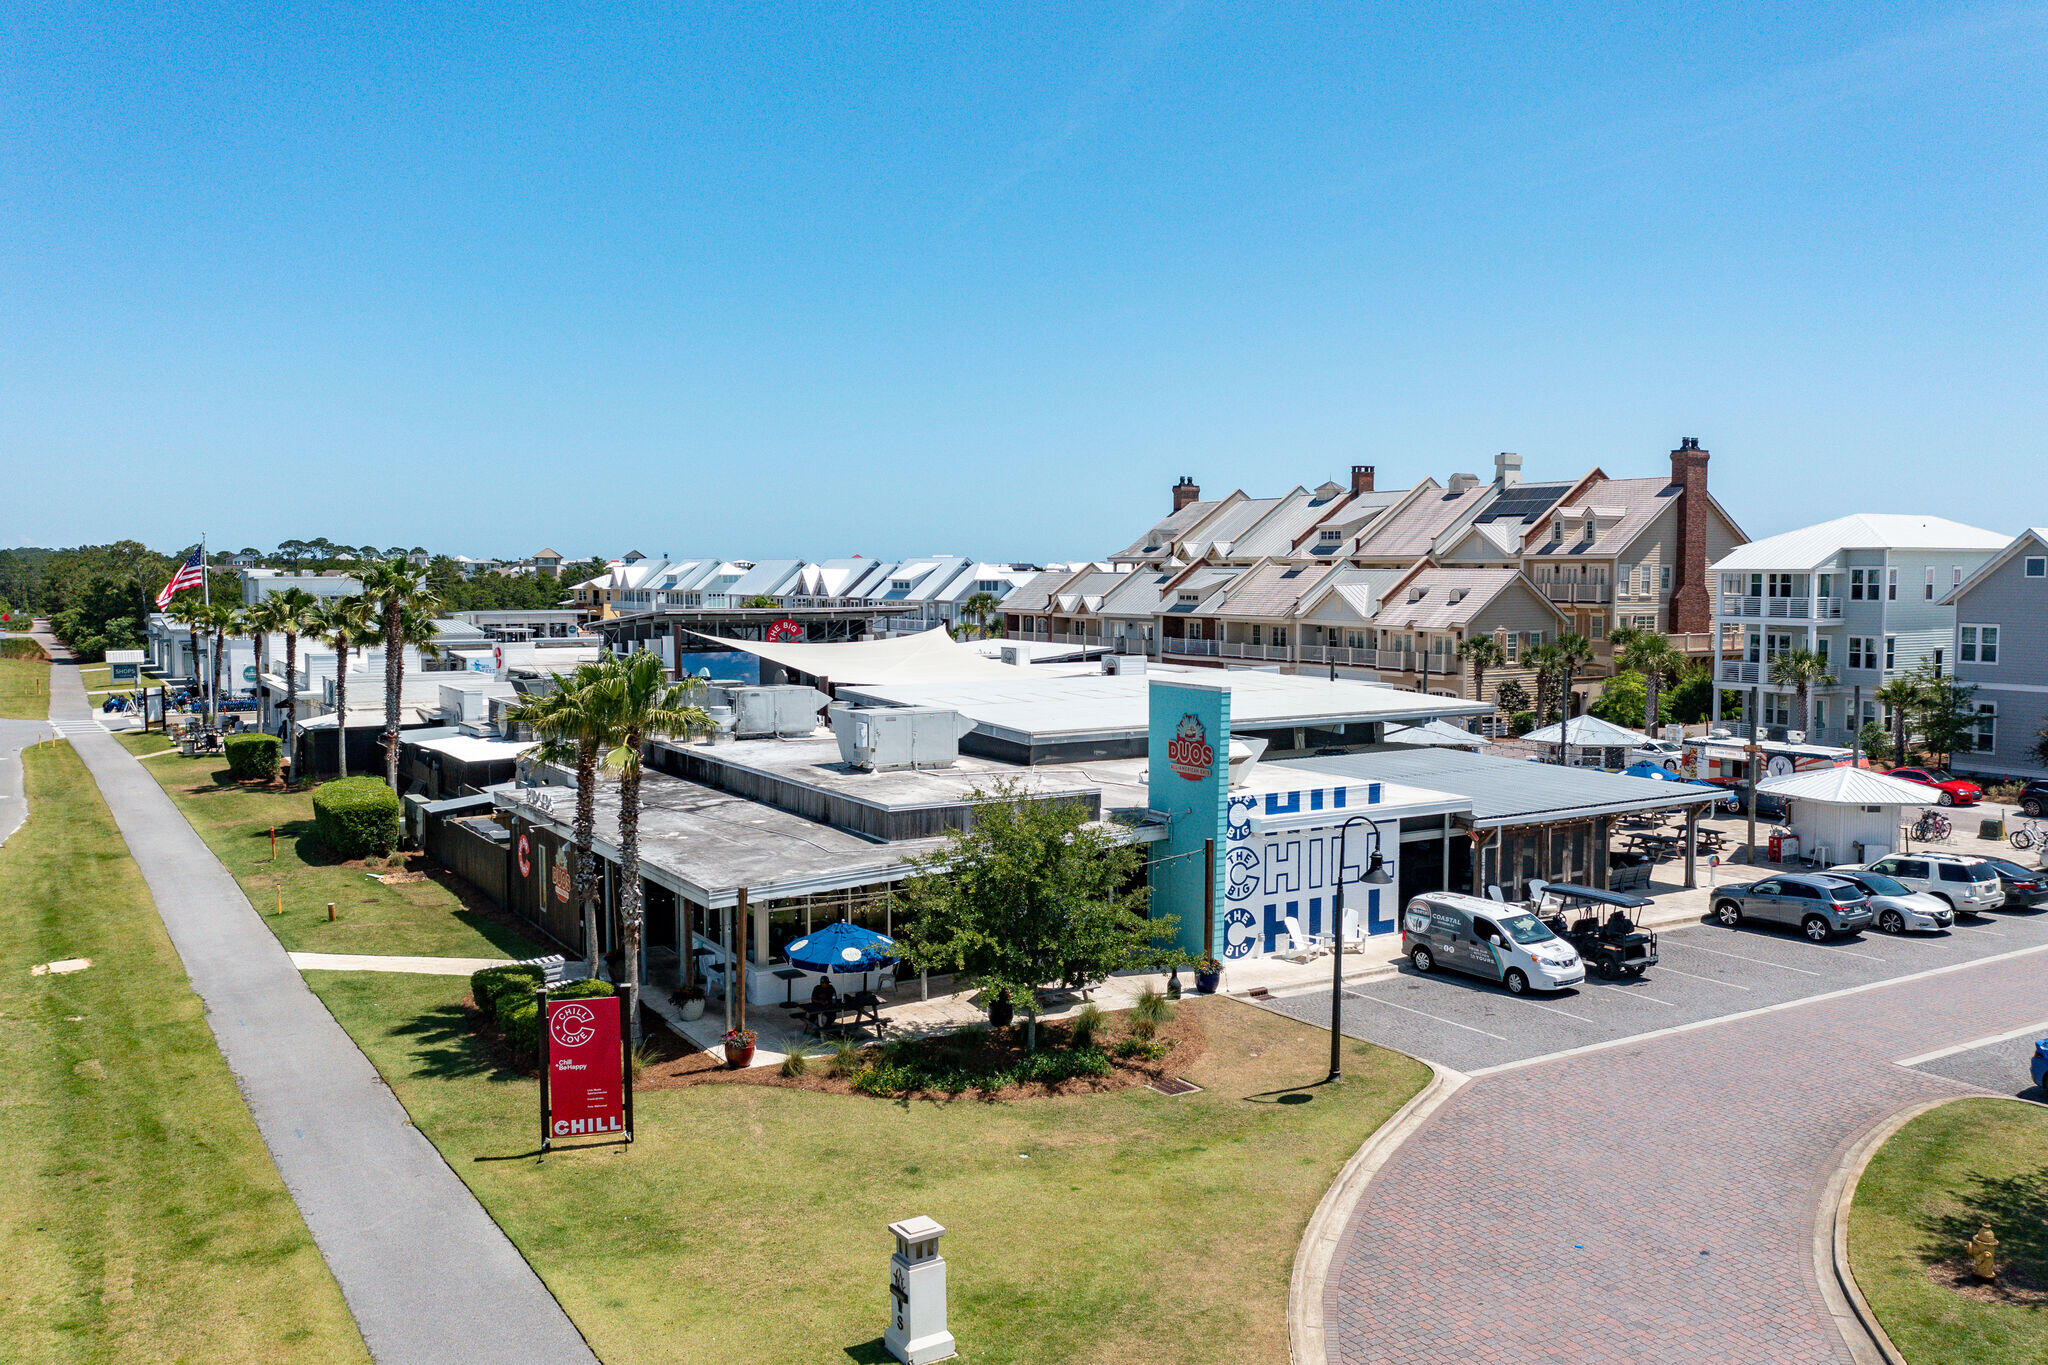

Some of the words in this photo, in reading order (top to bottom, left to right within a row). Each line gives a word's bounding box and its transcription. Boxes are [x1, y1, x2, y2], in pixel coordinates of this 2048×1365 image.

[769, 624, 781, 641] THE
[783, 621, 798, 633] BIG
[1168, 739, 1214, 767] DUOS
[1226, 825, 1250, 840] BIG
[1227, 851, 1253, 865] THE
[1227, 883, 1250, 897] BIG
[1225, 910, 1251, 925] THE
[1432, 913, 1461, 925] COASTAL
[1225, 944, 1249, 957] BIG
[558, 1007, 588, 1020] CHILL
[561, 1031, 588, 1044] LOVE
[554, 1116, 622, 1136] CHILL
[897, 1315, 904, 1330] S
